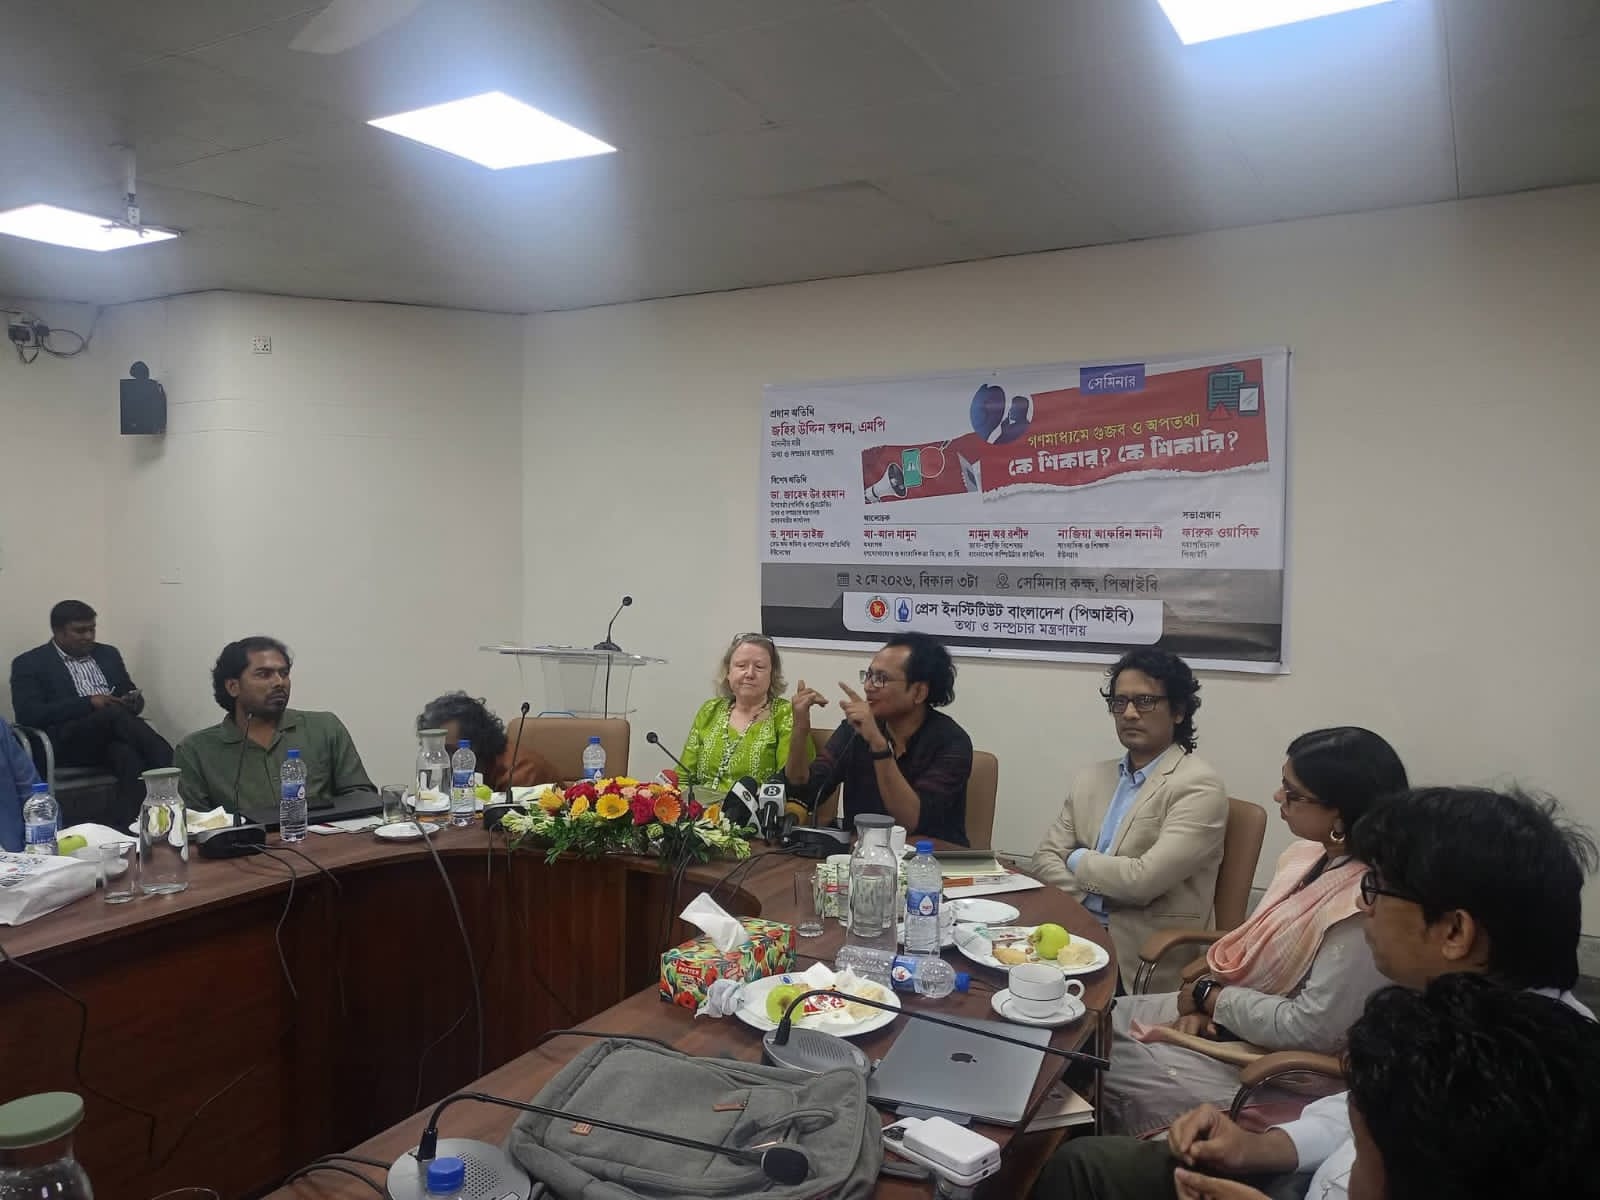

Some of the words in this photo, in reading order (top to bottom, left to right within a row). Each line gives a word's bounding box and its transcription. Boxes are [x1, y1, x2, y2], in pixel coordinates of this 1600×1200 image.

[1088, 372, 1136, 390] সেমিনার
[771, 421, 796, 437] জহির
[798, 420, 825, 435] উদ্দিন
[828, 422, 855, 435] স্বপন,
[858, 416, 886, 433] এমপি
[1027, 427, 1089, 449] গণমাধ্যমে
[1094, 422, 1125, 441] গুজব
[1130, 421, 1142, 436] ও
[1146, 412, 1201, 434] অপতথ্য
[1009, 457, 1033, 476] কে
[1038, 447, 1112, 473] শিকার?
[1118, 442, 1145, 463] কে
[1150, 429, 1239, 459] শিকারি?
[897, 529, 917, 541] মামুন
[968, 529, 990, 542] মামুন
[855, 573, 863, 586] ২
[865, 574, 878, 586] মে
[881, 574, 916, 589] ২০২৬,
[919, 571, 953, 588] বিকাল
[957, 572, 978, 588] ৩টা
[1017, 572, 1066, 591] সেমিনার
[1070, 577, 1099, 592] কক্ষ,
[1103, 573, 1160, 592] পিআইবি
[915, 602, 938, 617] প্রেস
[941, 599, 1004, 619] ইনস্টিটিউট
[1007, 604, 1065, 621] বাংলাদেশ
[1068, 603, 1134, 626] (পিআইবি)
[954, 619, 977, 632] তথ্য
[981, 621, 990, 632] ও
[993, 621, 1036, 635] সম্প্রচার
[1038, 621, 1087, 637] মন্ত্রণালয়
